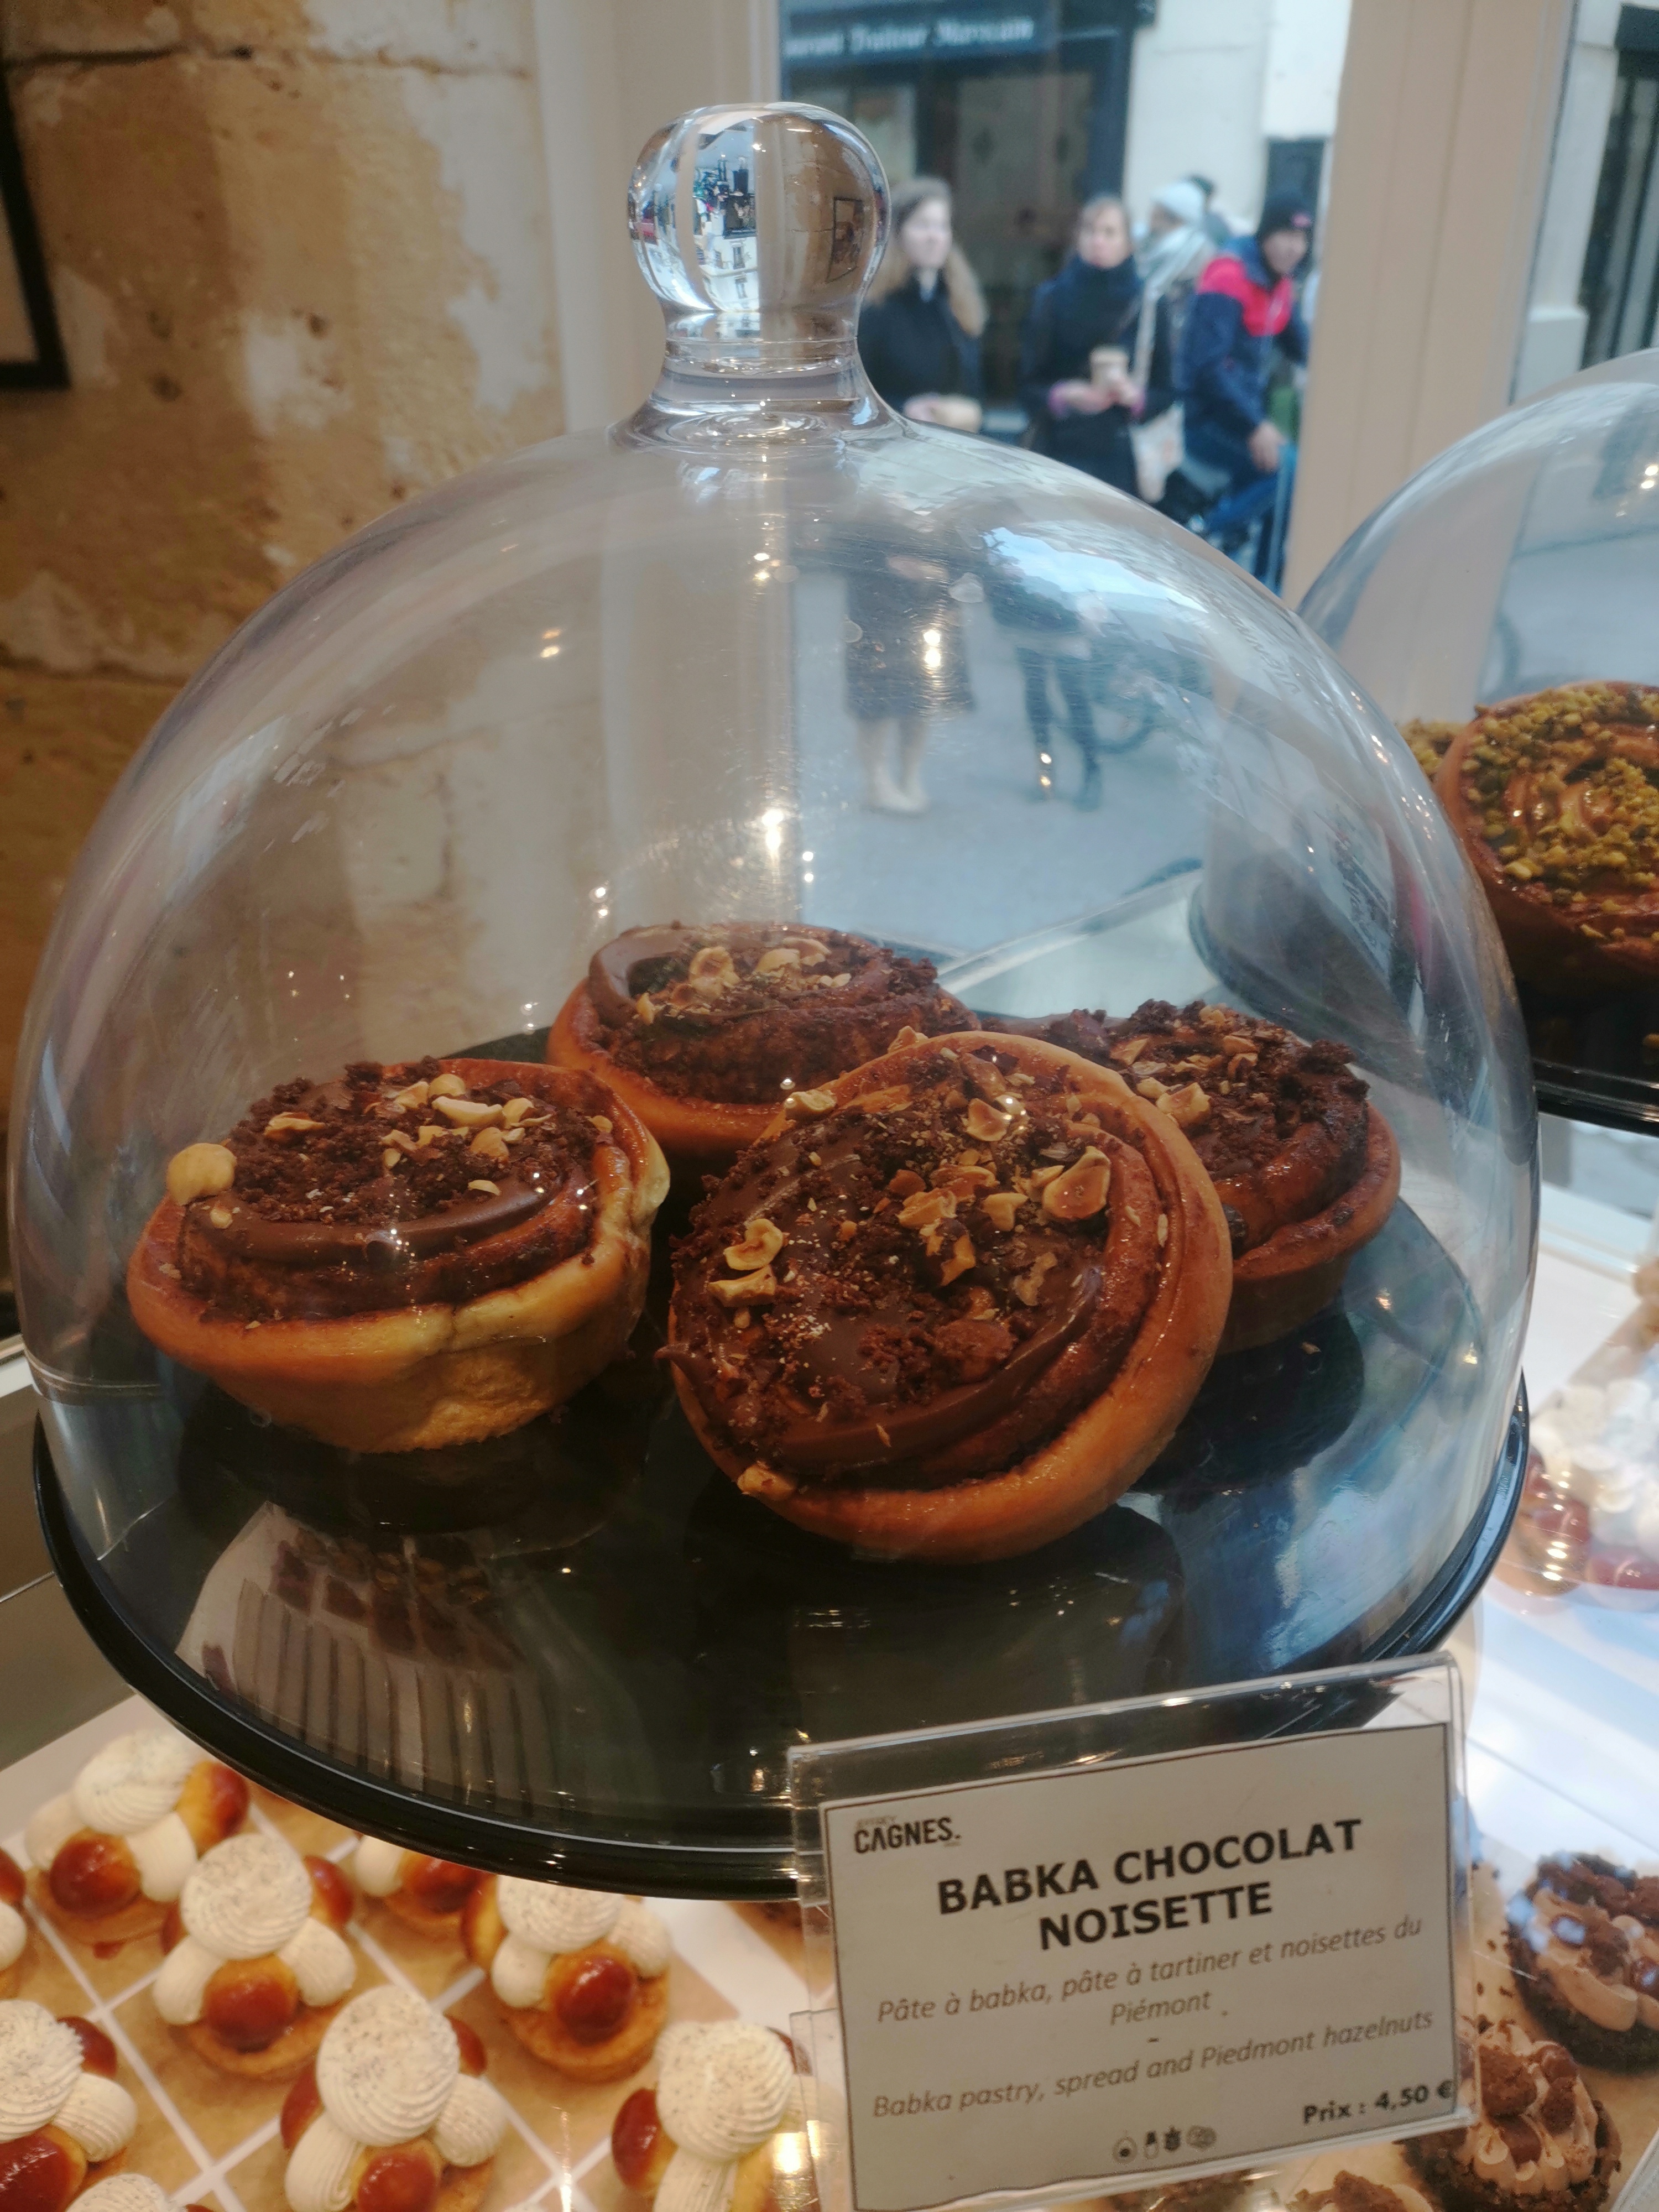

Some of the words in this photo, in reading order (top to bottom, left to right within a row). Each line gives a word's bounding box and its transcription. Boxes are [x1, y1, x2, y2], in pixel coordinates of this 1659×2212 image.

[938, 1859, 1099, 1914] BABKA
[1114, 1819, 1362, 1885] CHOCOLAT
[1040, 1881, 1272, 1950] NOISETTE
[878, 1998, 936, 2023] Pâte
[945, 1991, 961, 2015] à
[969, 1981, 1052, 2012] babka,
[1061, 1969, 1119, 2002] pâte
[1125, 1961, 1142, 1986] à
[1151, 1949, 1243, 1982] tartiner
[1248, 1942, 1274, 1965] et
[1280, 1924, 1387, 1959] noisettes
[1394, 1914, 1423, 1940] du
[1110, 1990, 1212, 2026] Piémont
[873, 2090, 952, 2118] Babka
[958, 2083, 1045, 2113] pastry,
[1054, 2060, 1140, 2098] spread
[1146, 2051, 1194, 2079] and
[1201, 2030, 1316, 2069] Piedmont
[1323, 2010, 1433, 2048] hazelnuts
[1303, 2099, 1352, 2125] Prix
[1374, 2085, 1430, 2112] 4,50
[1437, 2080, 1454, 2099] €
